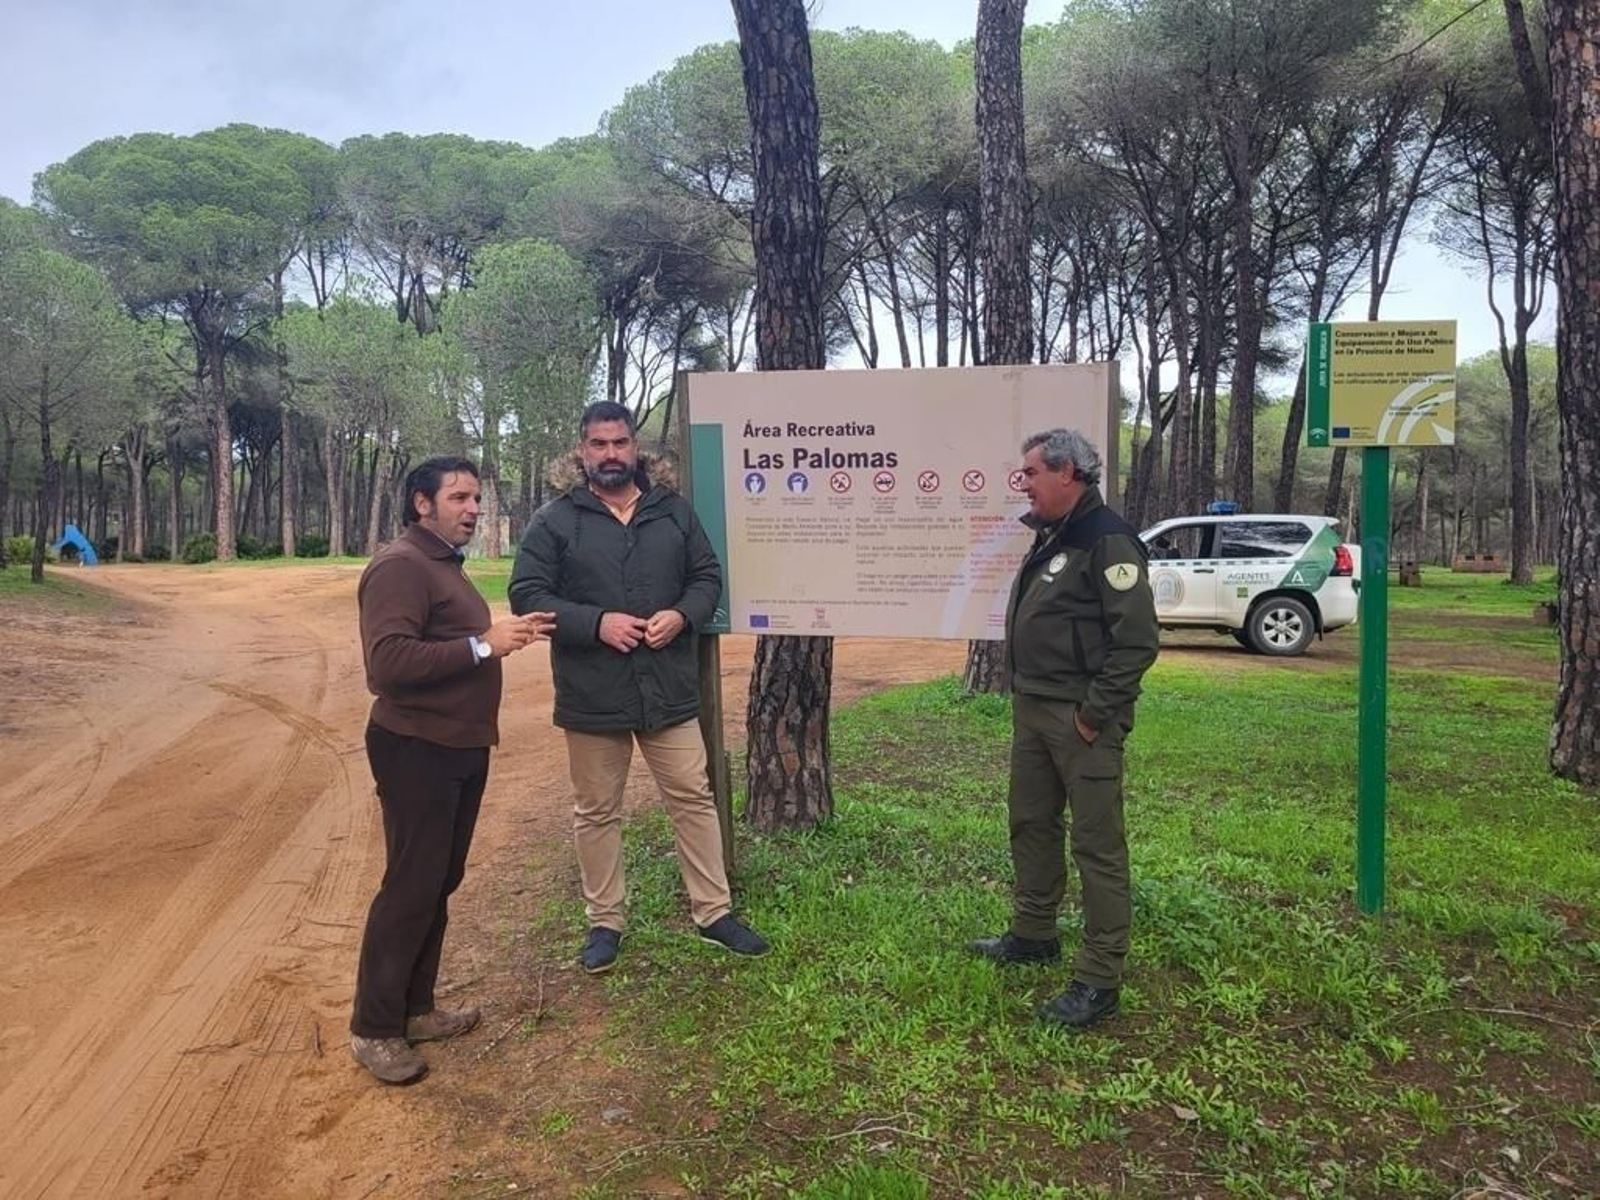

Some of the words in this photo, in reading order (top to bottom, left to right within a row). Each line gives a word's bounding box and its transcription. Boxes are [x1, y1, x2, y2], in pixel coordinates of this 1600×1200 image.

[743, 419, 782, 437] Área
[786, 422, 876, 437] Recreativa
[743, 448, 785, 469] Las
[793, 448, 898, 468] Palomas
